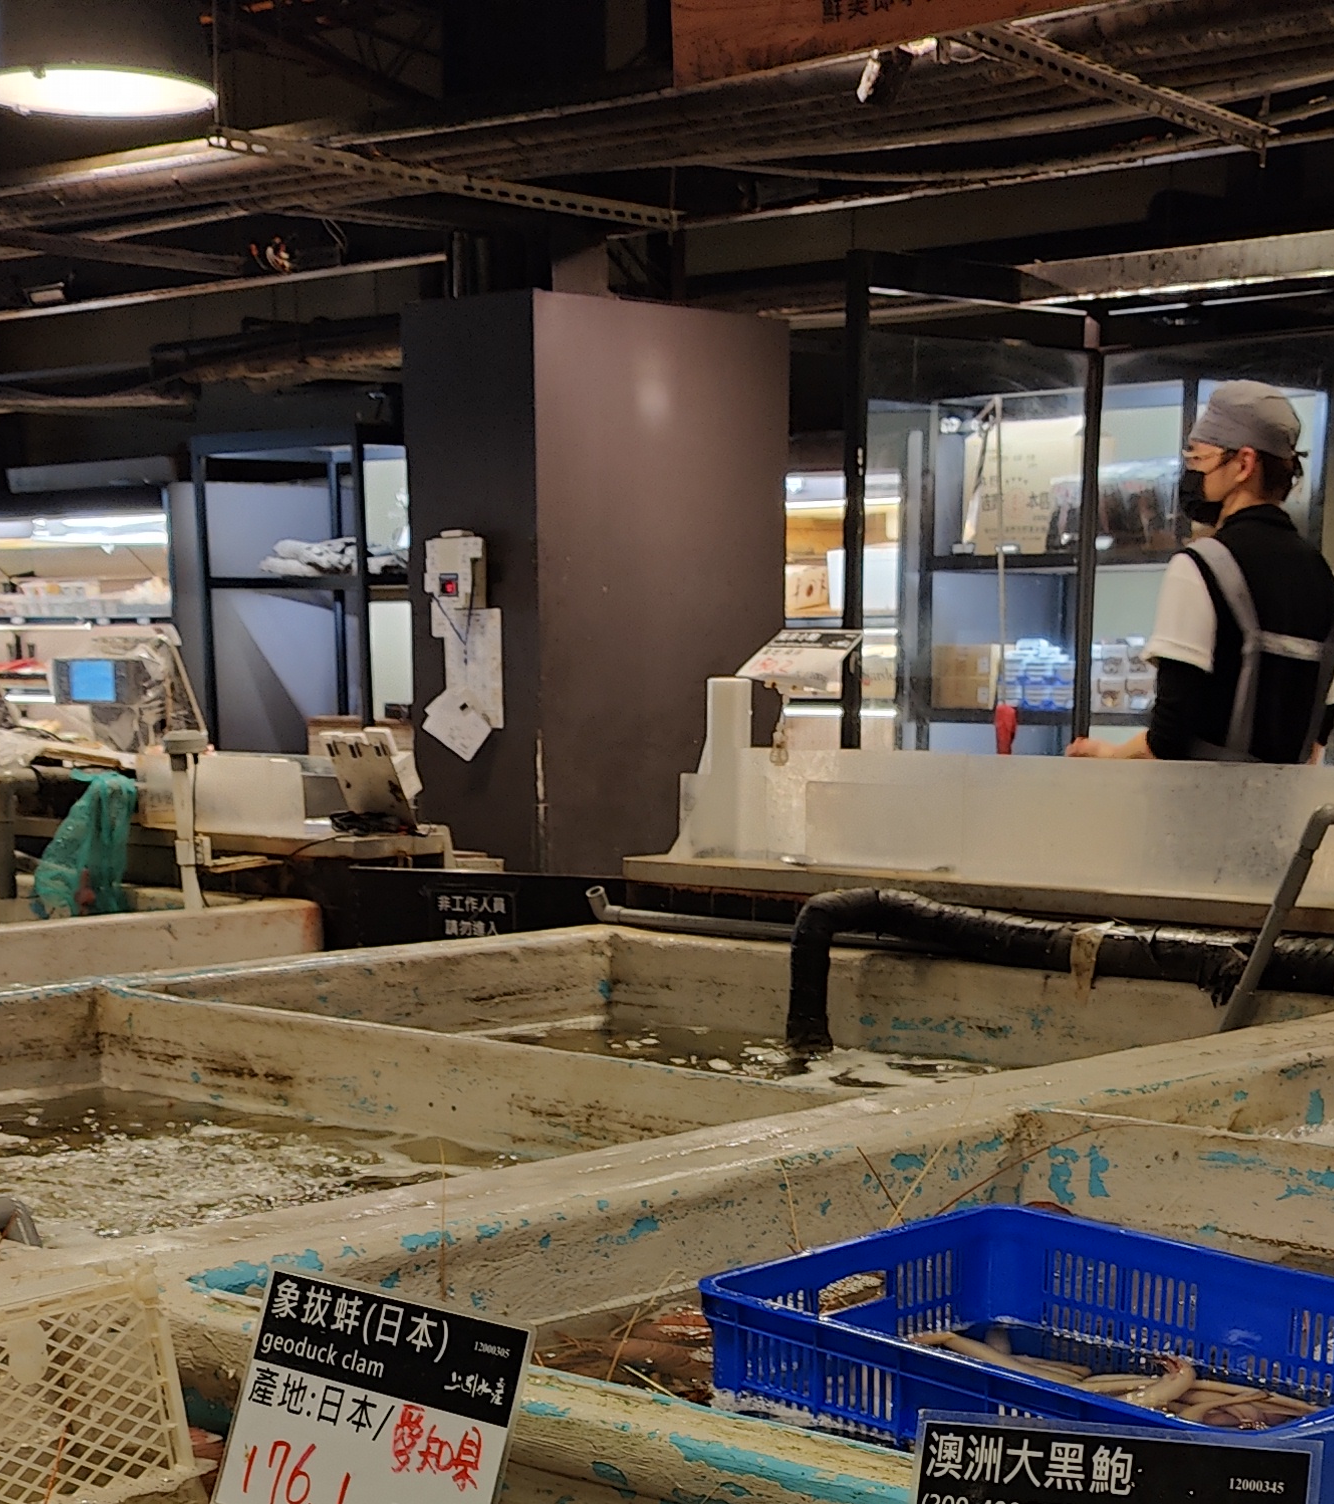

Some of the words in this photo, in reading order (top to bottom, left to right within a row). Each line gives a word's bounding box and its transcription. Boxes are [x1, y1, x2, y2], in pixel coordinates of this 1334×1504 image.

[437, 895, 506, 914] 非工作人員
[444, 919, 499, 936] 請勿進入
[271, 1279, 449, 1363] 象拔蚌(日本)
[261, 1330, 338, 1366] geoduck
[341, 1349, 385, 1378] clam
[474, 1341, 511, 1359] 12000305
[925, 1432, 1134, 1496] 澳洲大黑鮑
[1228, 1477, 1285, 1494] 12000345
